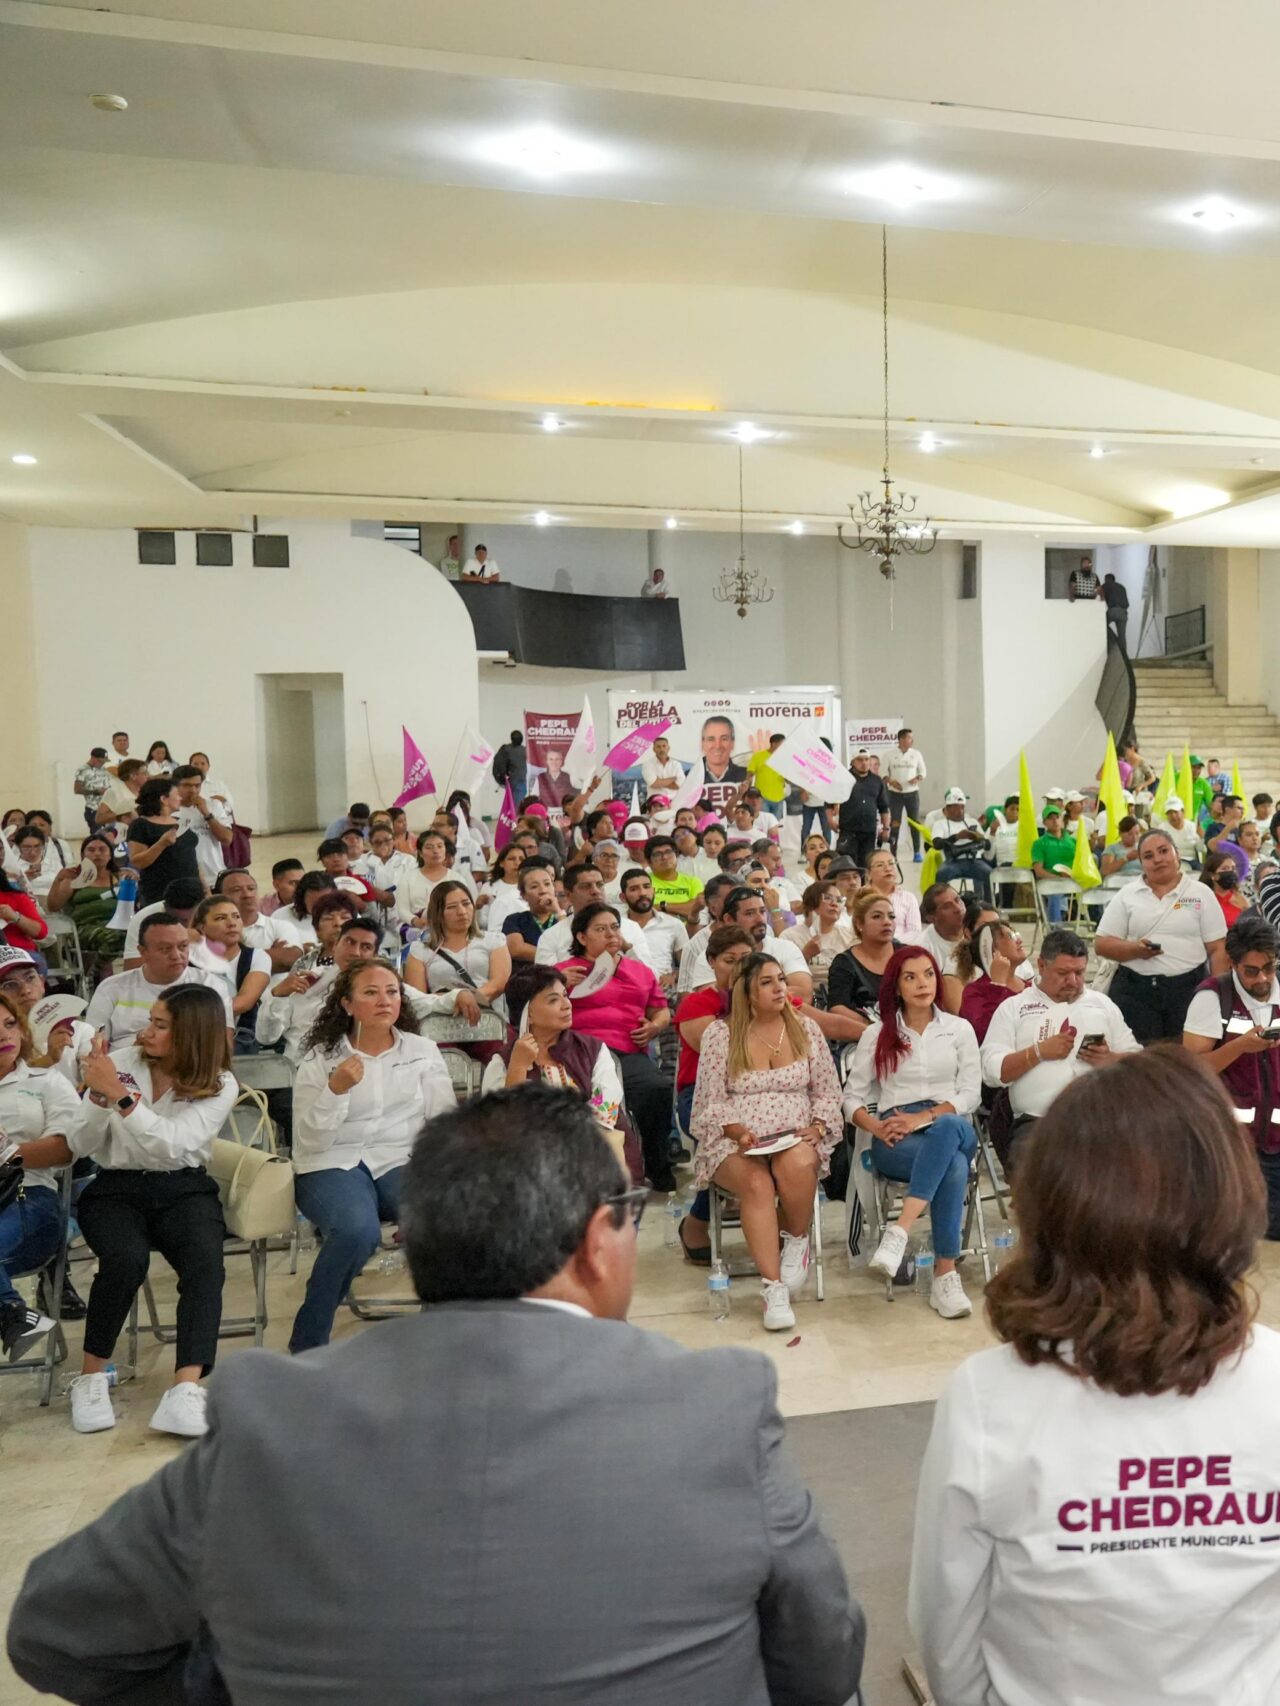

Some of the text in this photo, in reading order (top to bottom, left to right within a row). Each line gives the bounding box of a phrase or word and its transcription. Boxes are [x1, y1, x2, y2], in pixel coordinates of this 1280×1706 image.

[617, 705, 679, 720] PUEBLA
[749, 705, 812, 717] morena
[540, 719, 569, 729] PEPE
[861, 726, 888, 734] PEPE
[849, 734, 899, 742] CHEDRAU
[1118, 1455, 1232, 1491] PEPE
[1089, 1534, 1256, 1554] PRESIDENTE MUNICIPAL
